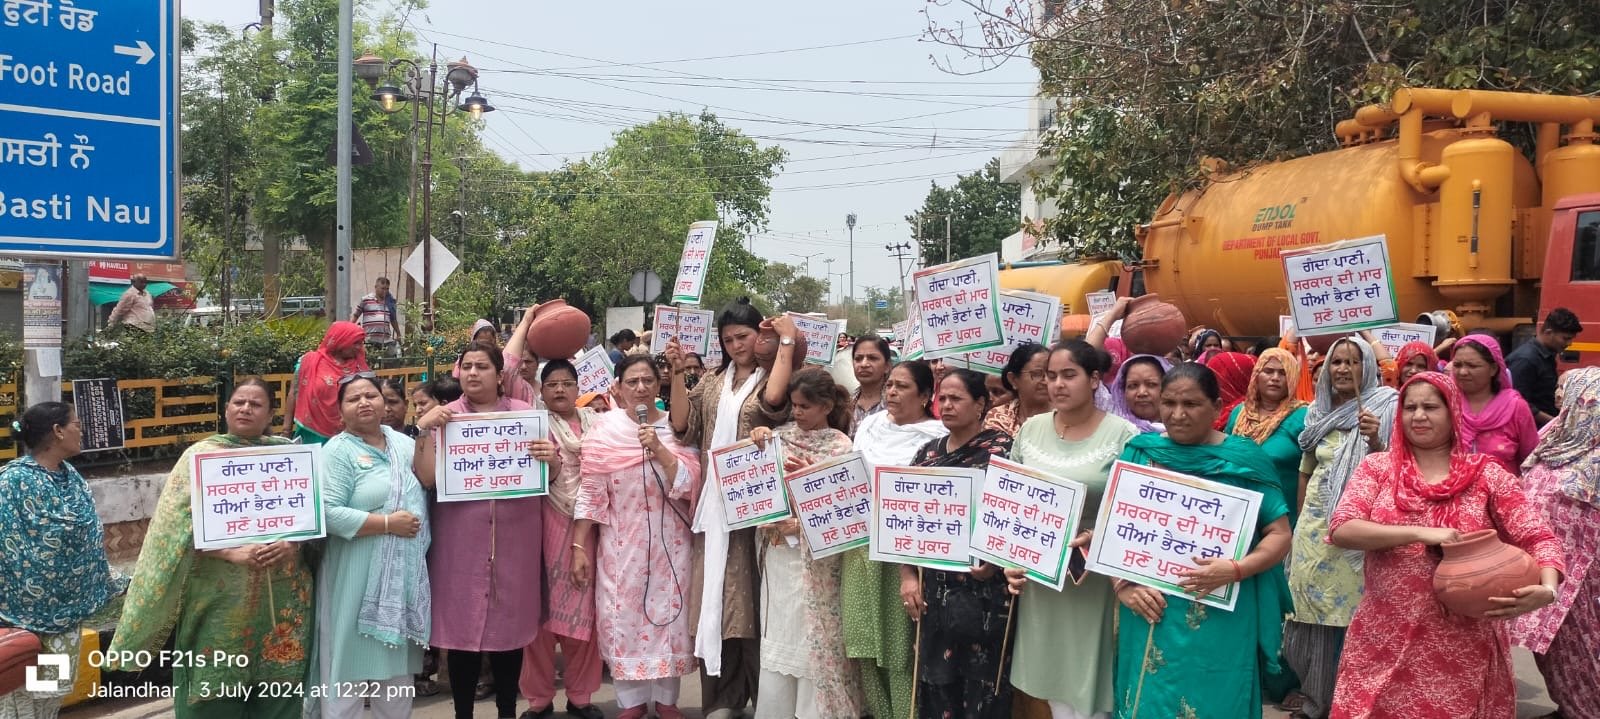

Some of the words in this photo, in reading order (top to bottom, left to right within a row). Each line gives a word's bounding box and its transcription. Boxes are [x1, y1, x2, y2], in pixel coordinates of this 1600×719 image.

[0, 54, 58, 87] Foot
[68, 63, 130, 96] Road
[88, 196, 150, 224] Nau
[1275, 221, 1292, 229] TANK
[1222, 237, 1266, 251] DEPARTMENT
[1267, 236, 1275, 247] OF
[1277, 234, 1299, 247] LOCAL
[1301, 232, 1320, 244] GOVT.
[1302, 258, 1330, 272] ਗੰਦਾ
[1334, 250, 1370, 267] ਪਾਣੀ,
[929, 277, 949, 292] ਗੰਦਾ
[952, 270, 980, 287] ਪਾਣੀ,
[1293, 276, 1333, 290] ਸਰਕਾਰ
[1338, 270, 1353, 284] ਦੀ
[1358, 268, 1382, 281] ਮਾਰ
[922, 296, 952, 311] ਸਰਕਾਰ
[955, 290, 967, 304] ਦੀ
[970, 288, 989, 301] ਮਾਰ
[1301, 291, 1330, 307] ਧੀਆਂ
[1333, 287, 1360, 302] ਭੈਣਾਂ
[1364, 283, 1381, 298] ਦੀ
[927, 312, 949, 328] ਧੀਆਂ
[951, 308, 972, 323] ਭੈਣਾਂ
[974, 304, 987, 319] ਦੀ
[1002, 303, 1034, 319] ਪਾਣੀ,
[1313, 308, 1334, 324] ਸੁਣੋ
[1340, 306, 1373, 321] ਪੁਕਾਰ
[937, 330, 953, 346] ਸੁਣੋ
[956, 327, 982, 343] ਪੁਕਾਰ
[1018, 323, 1042, 336] ਮਾਰ
[1382, 331, 1400, 340] ਗੰਦਾ
[462, 424, 490, 437] ਗੰਦਾ
[494, 422, 527, 436] ਪਾਣੀ,
[449, 444, 491, 455] ਸਰਕਾਰ
[495, 439, 510, 452] ਦੀ
[222, 460, 255, 476] ਗੰਦਾ
[260, 457, 298, 473] ਪਾਣੀ,
[454, 458, 484, 472] ਧੀਆਂ
[488, 455, 514, 469] ਭੈਣਾਂ
[517, 454, 533, 468] ਦੀ
[726, 454, 743, 469] ਗੰਦਾ
[464, 475, 485, 490] ਸੁਣੋ
[490, 475, 523, 488] ਪੁਕਾਰ
[721, 470, 745, 487] ਸਰਕਾਰ
[748, 465, 759, 478] ਦੀ
[760, 463, 776, 475] ਮਾਰ
[803, 478, 826, 494] ਗੰਦਾ
[828, 467, 855, 484] ਪਾਣੀ,
[206, 482, 256, 496] ਸਰਕਾਰ
[262, 477, 279, 491] ਦੀ
[284, 478, 309, 490] ਮਾਰ
[727, 486, 744, 501] ਧੀਆਂ
[746, 480, 764, 496] ਭੈਣਾਂ
[766, 477, 777, 491] ਦੀ
[799, 494, 833, 512] ਸਰਕਾਰ
[834, 487, 847, 500] ਦੀ
[848, 482, 868, 498] ਮਾਰ
[894, 477, 920, 494] ਗੰਦਾ
[924, 480, 957, 498] ਪਾਣੀ,
[998, 474, 1024, 494] ਗੰਦਾ
[1027, 485, 1059, 508] ਪਾਣੀ,
[213, 498, 250, 514] ਧੀਆਂ
[254, 494, 283, 510] ਭੈਣਾਂ
[288, 493, 305, 507] ਦੀ
[736, 502, 749, 519] ਸੁਣੋ
[752, 499, 772, 514] ਪੁਕਾਰ
[882, 498, 920, 513] ਸਰਕਾਰ
[924, 499, 940, 514] ਦੀ
[944, 504, 967, 516] ਮਾਰ
[981, 492, 1021, 515] ਸਰਕਾਰ
[1023, 504, 1040, 520] ਦੀ
[1041, 512, 1065, 529] ਮਾਰ
[1138, 481, 1177, 503] ਗੰਦਾ
[1181, 494, 1226, 521] ਪਾਣੀ,
[808, 510, 832, 528] ਧੀਆਂ
[833, 503, 853, 520] ਭੈਣਾਂ
[855, 499, 871, 514] ਦੀ
[1115, 501, 1173, 527] ਸਰਕਾਰ
[1176, 516, 1199, 534] ਦੀ
[1202, 523, 1235, 544] ਮਾਰ
[226, 517, 251, 535] ਸੁਣੋ
[257, 516, 295, 532] ਪੁਕਾਰ
[822, 526, 838, 544] ਸੁਣੋ
[842, 521, 867, 539] ਪੁਕਾਰ
[886, 514, 914, 531] ਧੀਆਂ
[916, 515, 942, 533] ਭੈਣਾਂ
[946, 520, 962, 536] ਦੀ
[982, 510, 1010, 531] ਧੀਆਂ
[1012, 517, 1038, 539] ਭੈਣਾਂ
[1040, 531, 1056, 549] ਦੀ
[895, 535, 914, 551] ਸੁਣੋ
[918, 540, 951, 554] ਪੁਕਾਰ
[986, 535, 1006, 550] ਸੁਣੋ
[1009, 543, 1042, 564] ਪੁਕਾਰ
[1116, 522, 1158, 546] ਧੀਆਂ
[1160, 530, 1197, 555] ਭੈਣਾਂ
[1122, 549, 1153, 568] ਸੁਣੋ
